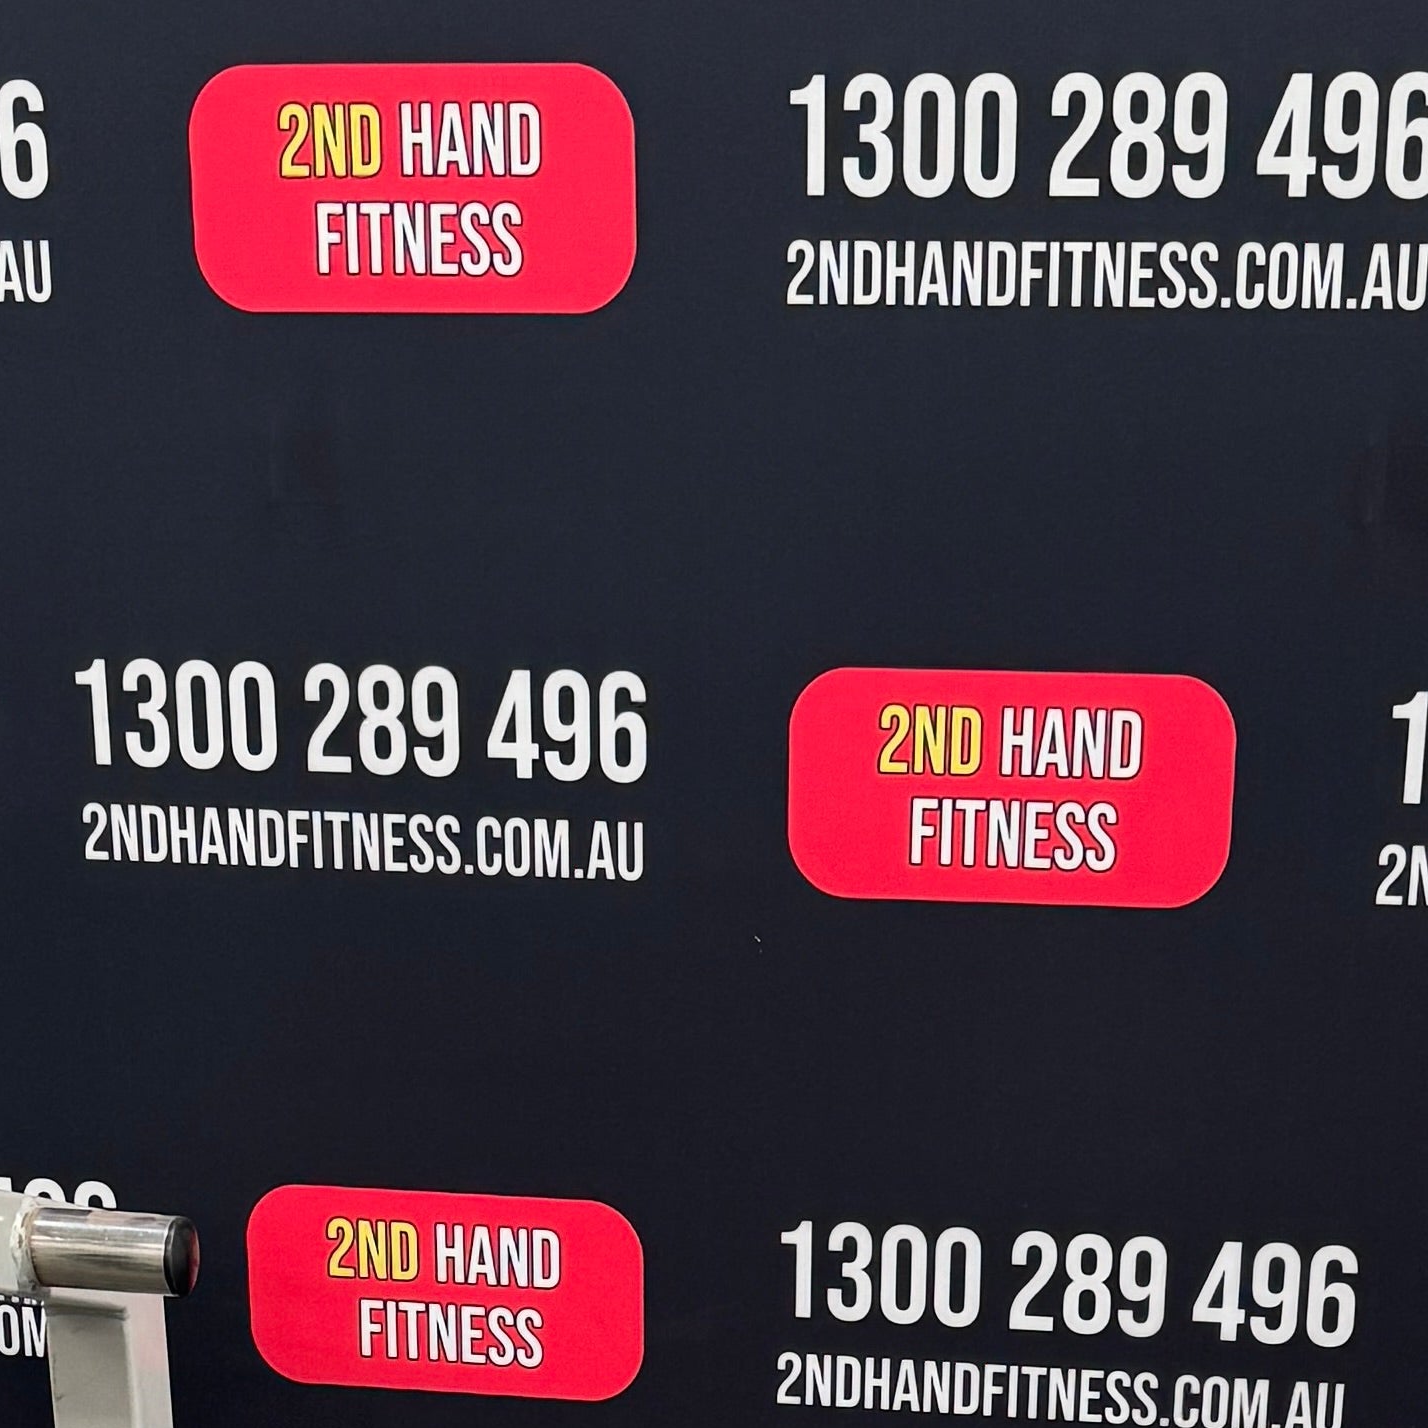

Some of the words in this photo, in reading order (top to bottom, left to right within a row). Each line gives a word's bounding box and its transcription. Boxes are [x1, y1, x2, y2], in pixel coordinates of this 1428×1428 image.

[278, 102, 382, 178] 2ND
[399, 101, 542, 177] HAND
[788, 71, 1019, 200] 1300
[1047, 70, 1229, 200] 289
[315, 201, 523, 277] FITNESS
[73, 657, 279, 773] 1300
[303, 661, 461, 779] 289
[486, 667, 648, 785] 496
[878, 703, 983, 776] 2ND
[1000, 706, 1143, 779] HAND
[81, 801, 645, 883] 2NDHANDFITNESS.COM.AU
[910, 796, 1118, 872] FITNESS
[326, 1216, 419, 1281] 2ND
[434, 1222, 561, 1289] HAND
[779, 1219, 983, 1329] 1300
[1007, 1229, 1169, 1339] 289
[1190, 1240, 1360, 1349] 496
[359, 1298, 544, 1369] FITNESS
